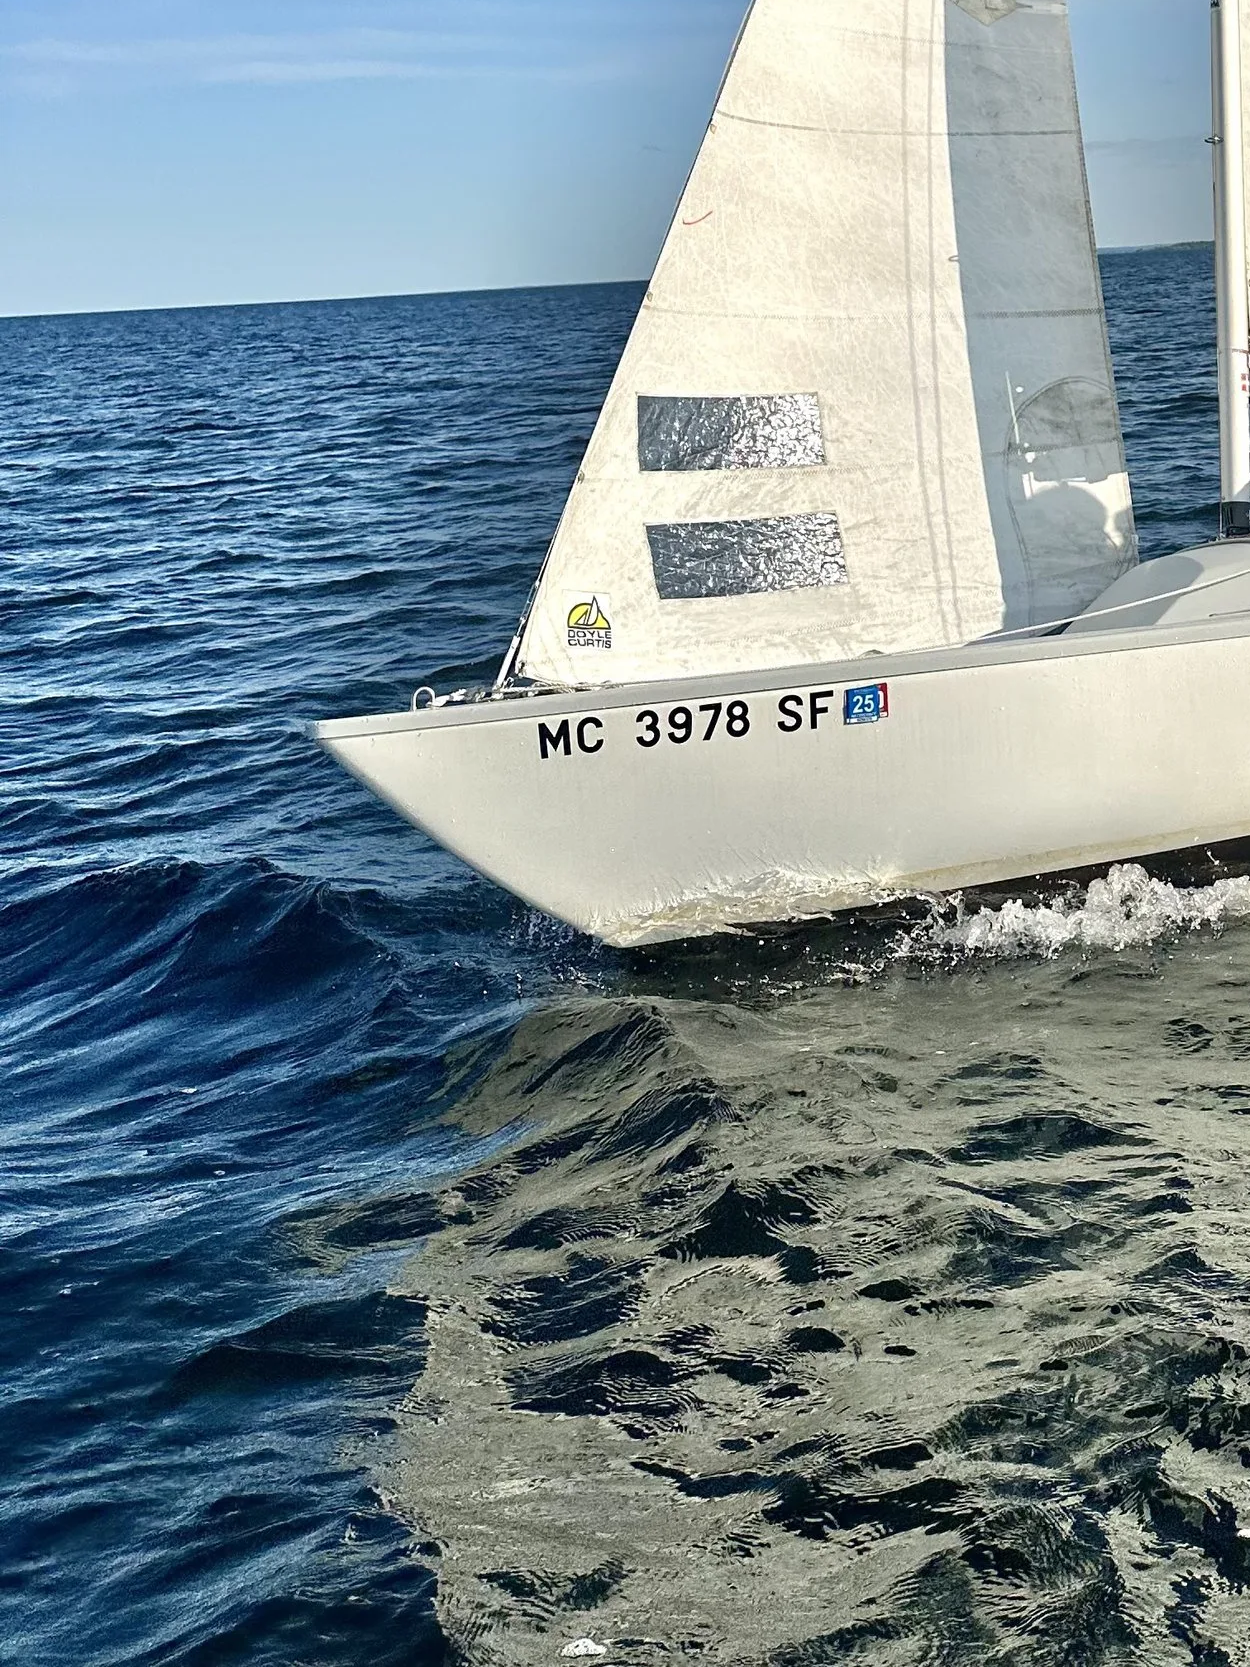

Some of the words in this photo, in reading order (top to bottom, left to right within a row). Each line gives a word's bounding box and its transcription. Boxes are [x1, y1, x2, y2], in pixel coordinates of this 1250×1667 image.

[567, 629, 612, 639] DOYLE
[567, 638, 612, 649] CURTIS
[852, 694, 875, 714] 25
[538, 716, 605, 759] MC
[635, 700, 750, 748] 3978
[777, 690, 834, 733] SF
